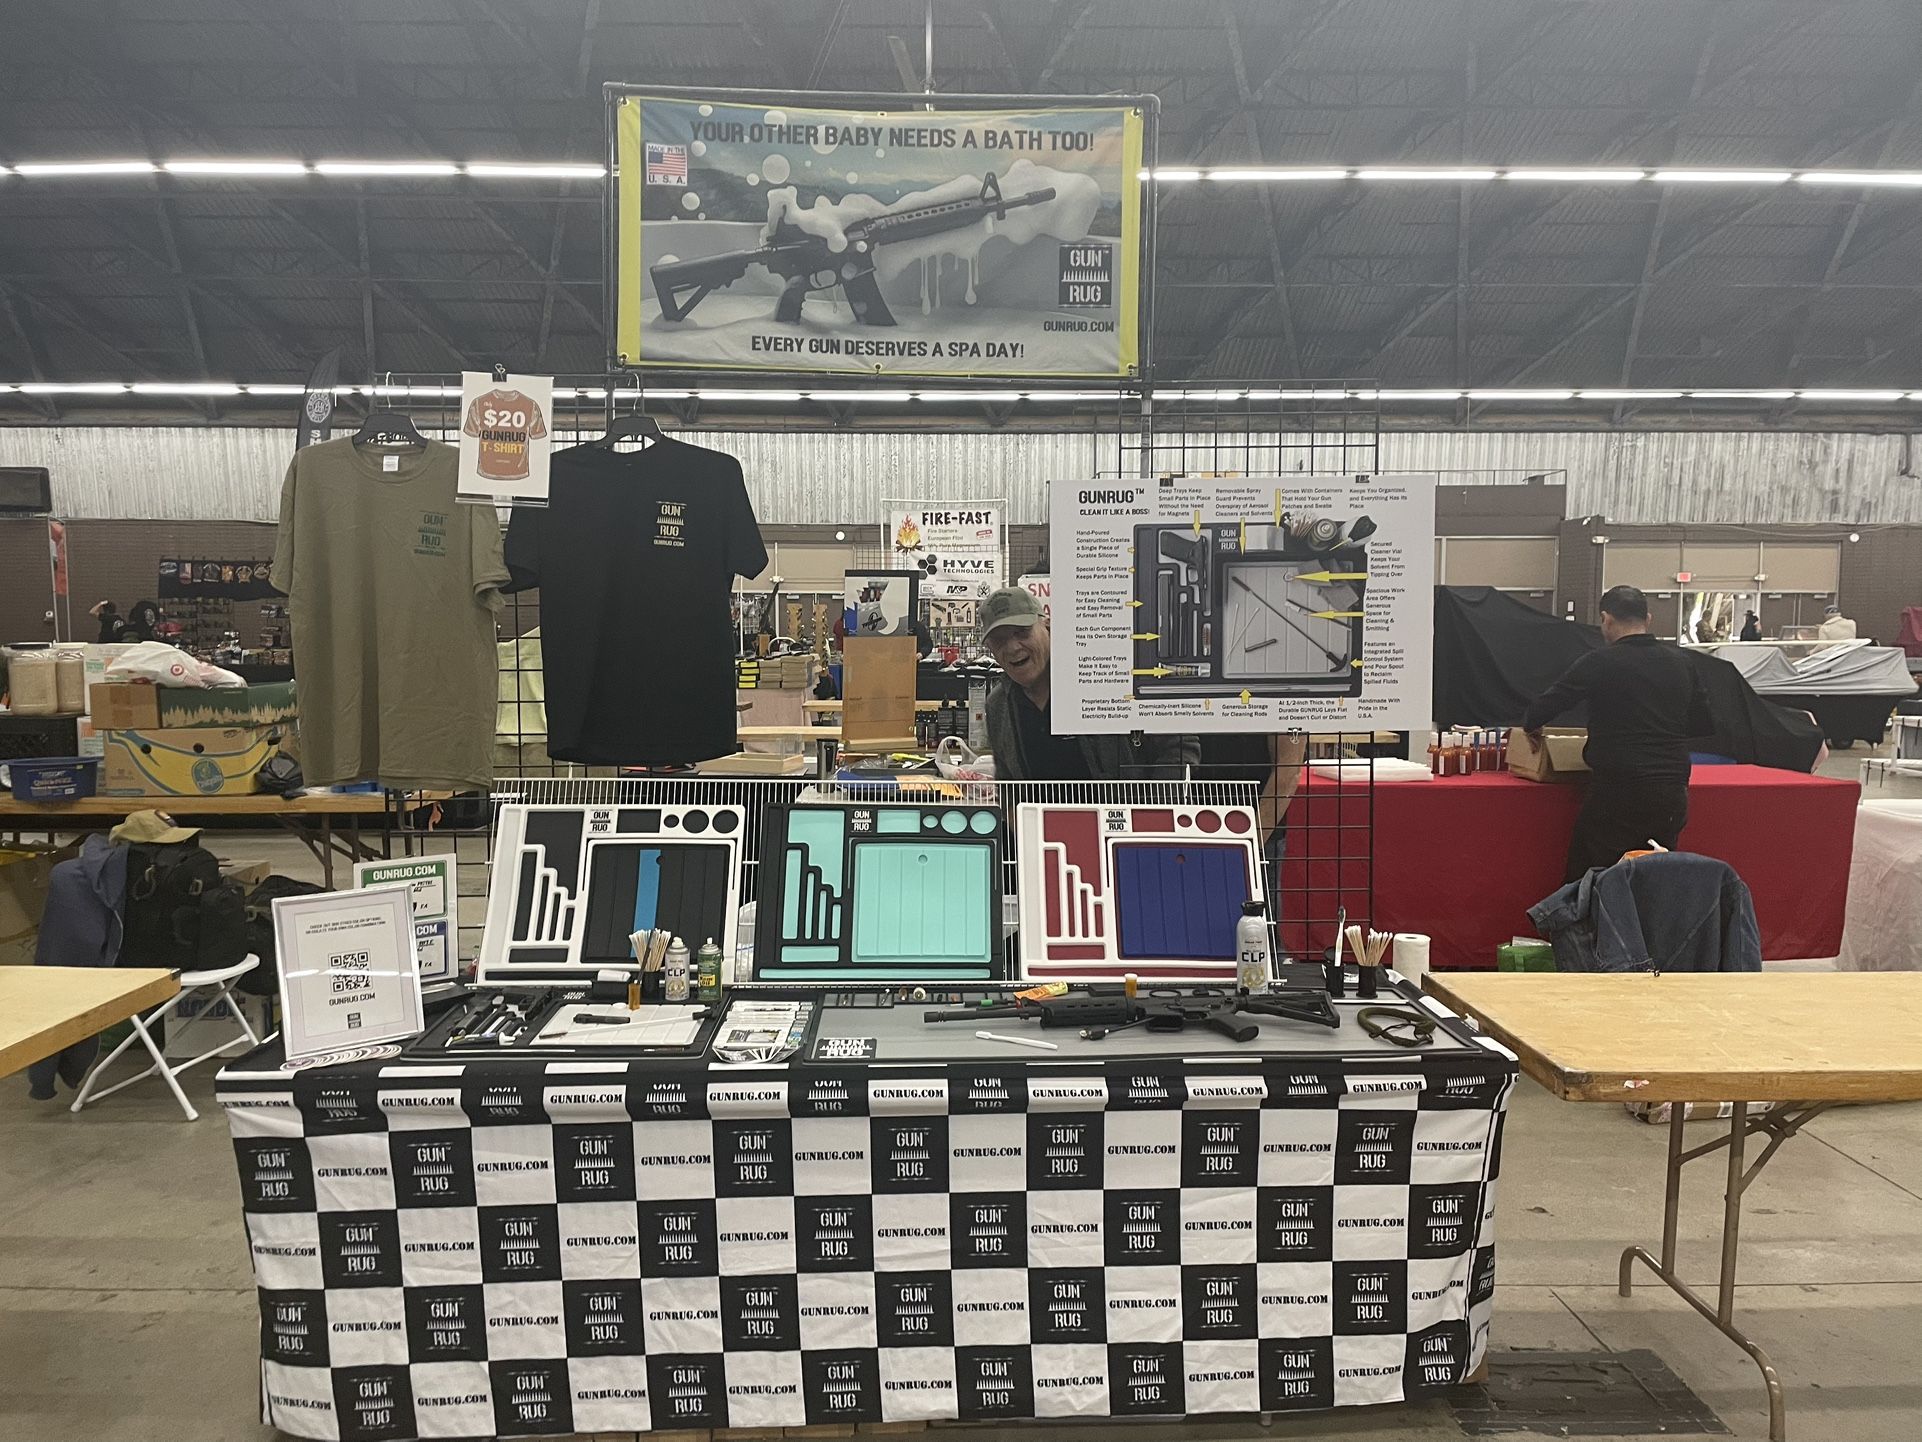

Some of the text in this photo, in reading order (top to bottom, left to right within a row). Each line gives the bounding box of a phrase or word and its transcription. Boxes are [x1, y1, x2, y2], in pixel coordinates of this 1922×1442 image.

[690, 121, 1094, 152] YOUR OTHER BABY NEEDS A BATH TOO!
[1070, 249, 1102, 267] GUN
[1070, 284, 1102, 302] RUG
[1044, 320, 1114, 332] GUNRUG.COM
[752, 336, 1024, 359] EVERY GUN DESERVES A SPA DAY!
[484, 408, 526, 428] $20
[481, 430, 526, 442] GUNRUG
[661, 505, 681, 516] GUN
[922, 511, 992, 526] FIRE-FAST
[660, 525, 679, 536] RUG
[943, 560, 994, 568] HYVE
[854, 810, 870, 818] GUN
[373, 864, 436, 880] GUNRUG.COM
[1242, 952, 1265, 962] CLP
[329, 993, 376, 1006] GUNRUG.COM
[1033, 1088, 1103, 1097] GUNRUG.COM
[1193, 1086, 1263, 1095] GUNRUG.COM
[1353, 1082, 1422, 1092] GUNRUG.COM
[550, 1094, 622, 1104] GUNRUG.COM
[873, 1089, 944, 1098] GUNRUG.COM
[382, 1098, 454, 1106] GUNRUG.COM
[1052, 1129, 1078, 1143] GUN
[1363, 1127, 1389, 1141] GUN
[580, 1139, 607, 1156] GUN
[953, 1148, 1022, 1157] GUNRUG.COM
[1417, 1142, 1482, 1151] GUNRUG.COM
[258, 1152, 284, 1167] GUN
[795, 1151, 864, 1161] GUNRUG.COM
[1360, 1154, 1386, 1169] RUG
[318, 1167, 387, 1176] GUNRUG.COM
[477, 1160, 548, 1172] GUNRUG.COM
[1052, 1158, 1078, 1174] RUG
[581, 1169, 608, 1186] RUG
[262, 1181, 288, 1196] RUG
[1433, 1199, 1460, 1214] GUN
[820, 1212, 847, 1227] GUN
[877, 1227, 946, 1237] GUNRUG.COM
[1185, 1222, 1252, 1231] GUNRUG.COM
[1432, 1227, 1458, 1242] RUG
[404, 1242, 475, 1252] GUNRUG.COM
[566, 1236, 636, 1246] GUNRUG.COM
[822, 1242, 848, 1256] RUG
[1357, 1277, 1384, 1291] GUN
[1109, 1299, 1176, 1309] GUNRUG.COM
[649, 1310, 718, 1321] GUNRUG.COM
[1356, 1305, 1383, 1320] RUG
[332, 1321, 401, 1332] GUNRUG.COM
[516, 1376, 544, 1390] GUN
[885, 1380, 952, 1389] GUNRUG.COM
[418, 1395, 487, 1406] GUNRUG.COM
[519, 1404, 547, 1420] RUG
